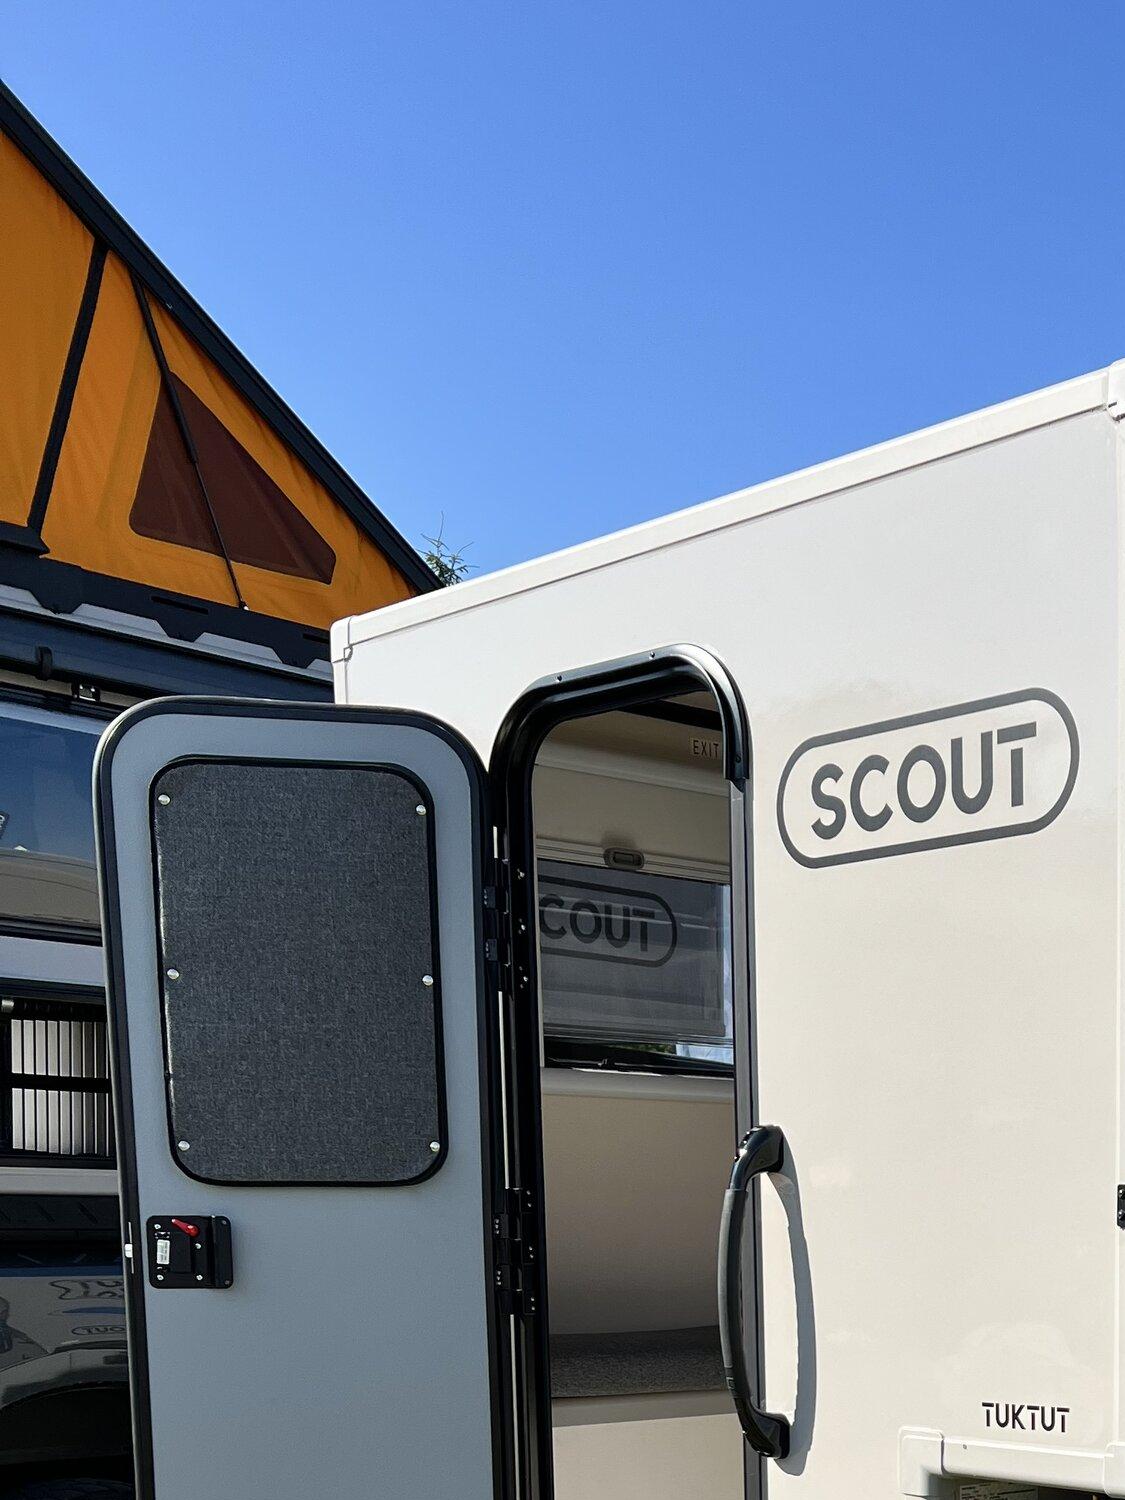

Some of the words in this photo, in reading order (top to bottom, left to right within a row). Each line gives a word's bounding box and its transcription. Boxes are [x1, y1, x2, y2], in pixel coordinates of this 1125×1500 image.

[692, 739, 719, 757] EXIT
[811, 721, 1037, 841] SCOUT
[538, 893, 656, 952] COUT
[981, 1401, 1070, 1433] TUKTUT
